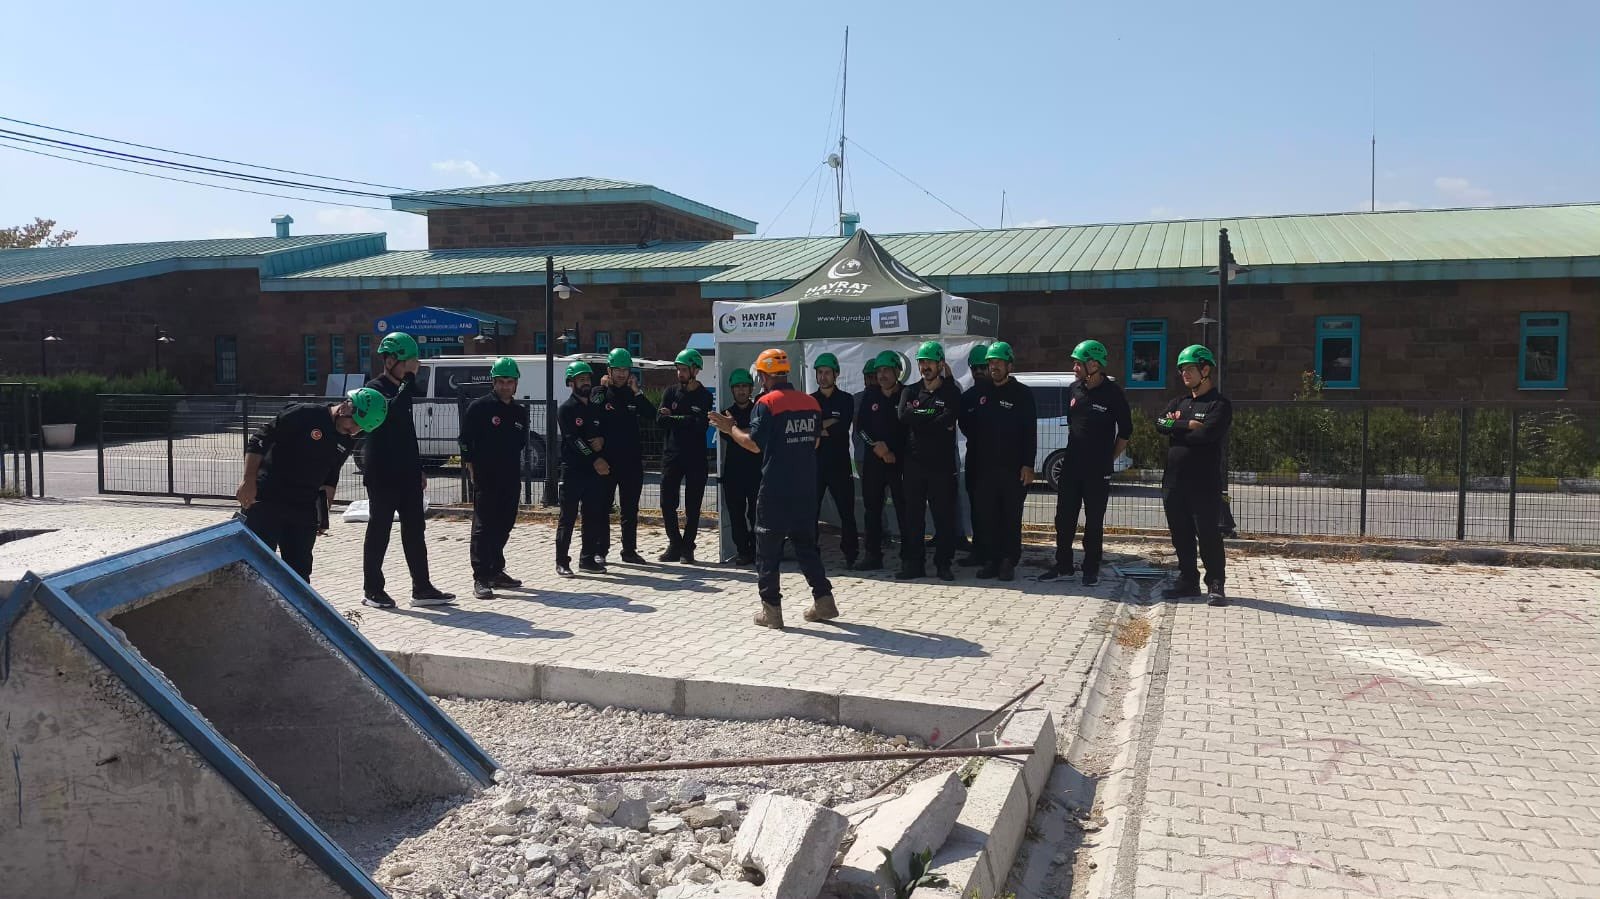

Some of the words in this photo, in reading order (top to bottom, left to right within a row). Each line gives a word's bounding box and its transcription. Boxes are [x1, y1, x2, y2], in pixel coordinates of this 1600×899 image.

[806, 281, 872, 293] HAYRAT
[742, 312, 776, 321] HAYRAT
[817, 314, 871, 323] www.hayratya
[785, 418, 815, 434] AFAD
